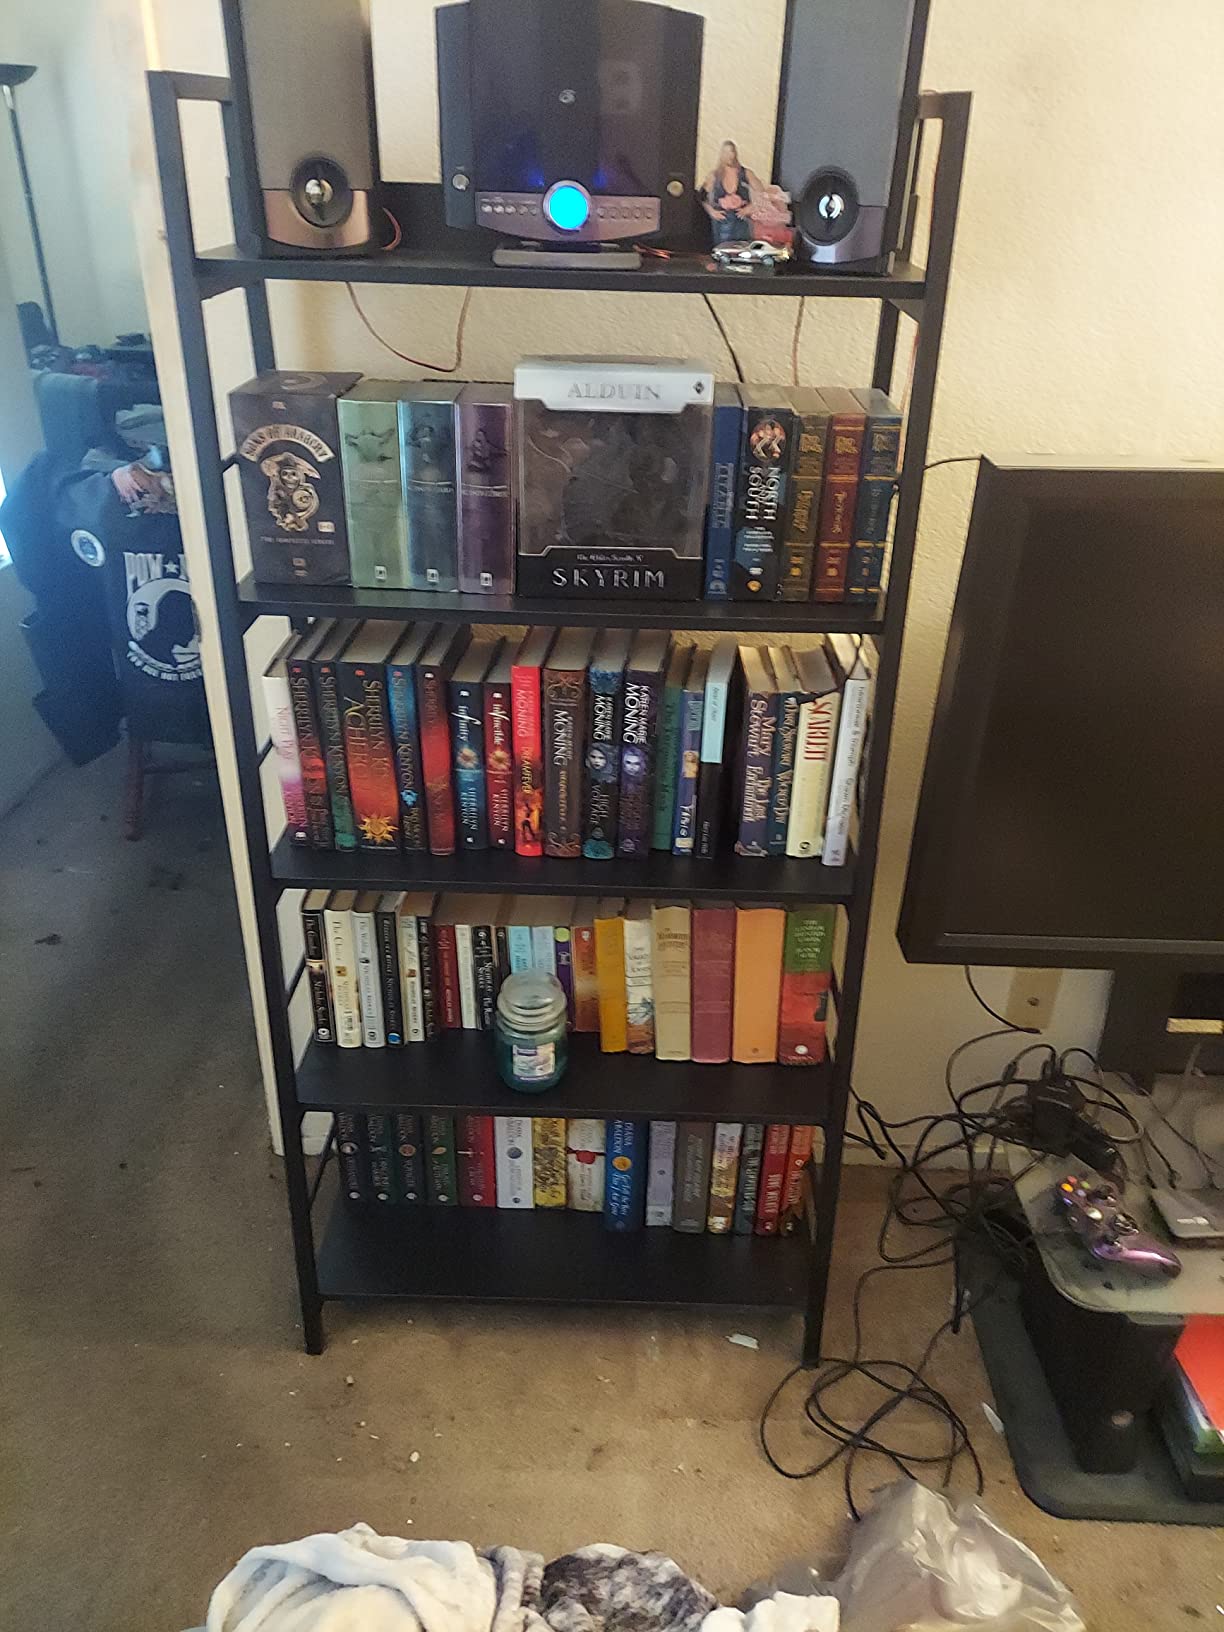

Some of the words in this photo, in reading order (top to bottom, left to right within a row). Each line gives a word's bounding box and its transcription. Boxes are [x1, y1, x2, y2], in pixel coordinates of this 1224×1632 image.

[568, 383, 662, 400] ALDUIN
[745, 466, 764, 521] SOUTH
[763, 466, 782, 521] NORTH
[552, 567, 665, 589] SKYRIM
[291, 676, 311, 743] SHERRILYN
[319, 676, 341, 741] SHERRILYN
[362, 680, 385, 750] SHERRILYN
[451, 705, 482, 742] infinity
[515, 689, 529, 737] MONING
[592, 694, 606, 741] MONING
[622, 682, 641, 744] MONING
[639, 685, 651, 716] KAREN
[553, 709, 568, 767] MONING
[636, 716, 649, 745] MARIE
[746, 700, 769, 757] Stewart
[759, 716, 778, 756] Mary
[803, 701, 833, 763] SCARLETT
[327, 744, 347, 794] KENYON
[398, 743, 415, 790] KENYON
[520, 746, 532, 794] DREAMFEVER
[757, 776, 773, 796] The
[742, 765, 764, 823] Enchantment
[613, 1119, 623, 1154] ABALDON
[623, 1122, 634, 1146] DIANA
